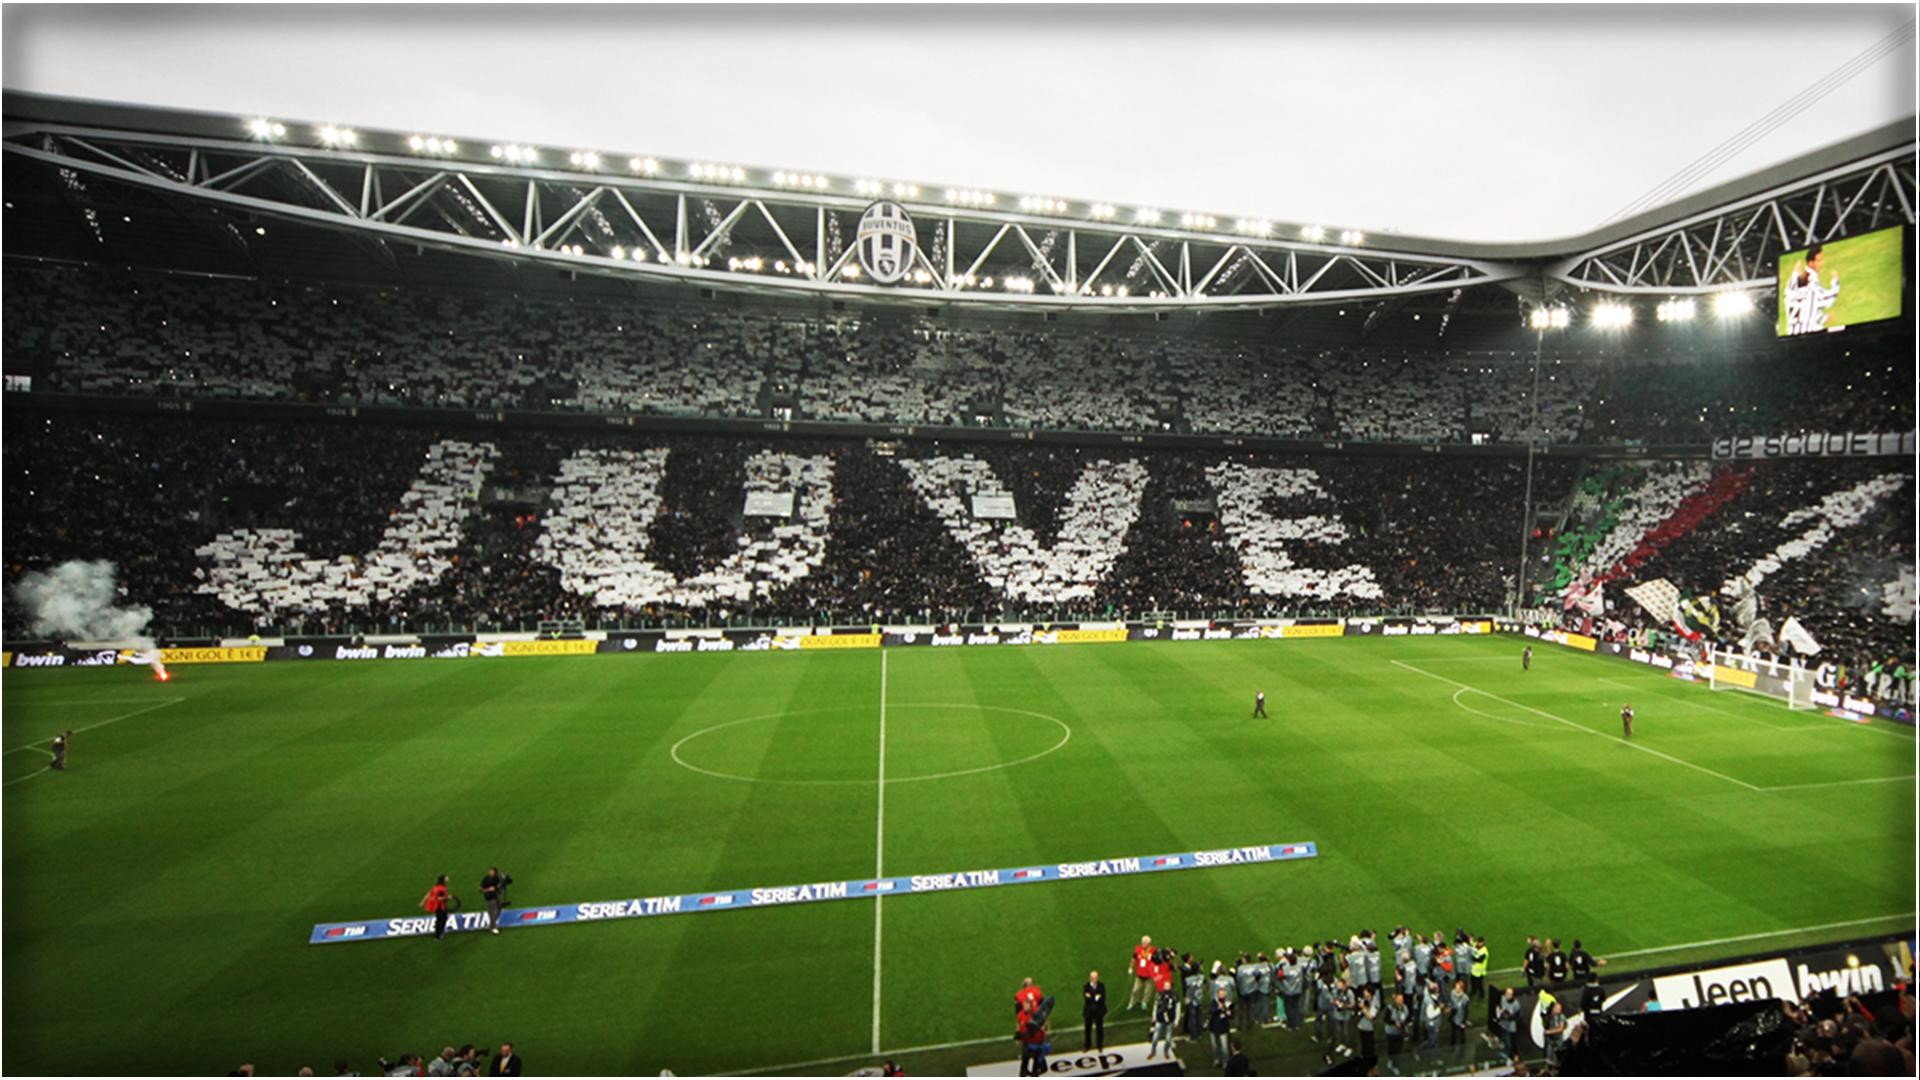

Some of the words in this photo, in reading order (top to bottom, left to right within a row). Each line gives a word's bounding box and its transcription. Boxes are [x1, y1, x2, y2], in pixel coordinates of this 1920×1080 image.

[863, 219, 913, 234] JUVENTUS
[1714, 437, 1753, 458] 32
[1763, 432, 1914, 456] SCUDETT
[197, 440, 1384, 610] JUVE
[195, 649, 222, 660] GOL
[336, 645, 378, 659] bwin
[384, 644, 426, 658] bwin
[656, 638, 692, 652] bwin
[697, 637, 734, 651] bwin
[16, 652, 65, 666] bwin
[1195, 852, 1232, 866] SERIE
[1231, 848, 1244, 863] A
[1243, 846, 1270, 861] TIM
[1058, 864, 1099, 878] SERIE
[1098, 860, 1111, 875] A
[1110, 858, 1140, 873] TIM
[911, 875, 954, 891] SERIE
[953, 873, 967, 888] A
[967, 870, 999, 885] TIM
[714, 896, 733, 905] TIM
[751, 888, 798, 904] SERIE
[797, 884, 812, 900] A
[812, 882, 847, 899] TIM
[535, 909, 557, 920] TIM
[576, 903, 627, 920] SERIE
[626, 899, 643, 915] A
[643, 896, 681, 913] TIM
[343, 926, 366, 937] TIM
[386, 917, 437, 936] SERIE
[444, 913, 459, 931] A
[1797, 956, 1884, 999] bwin
[1682, 974, 1771, 1008] Jeep
